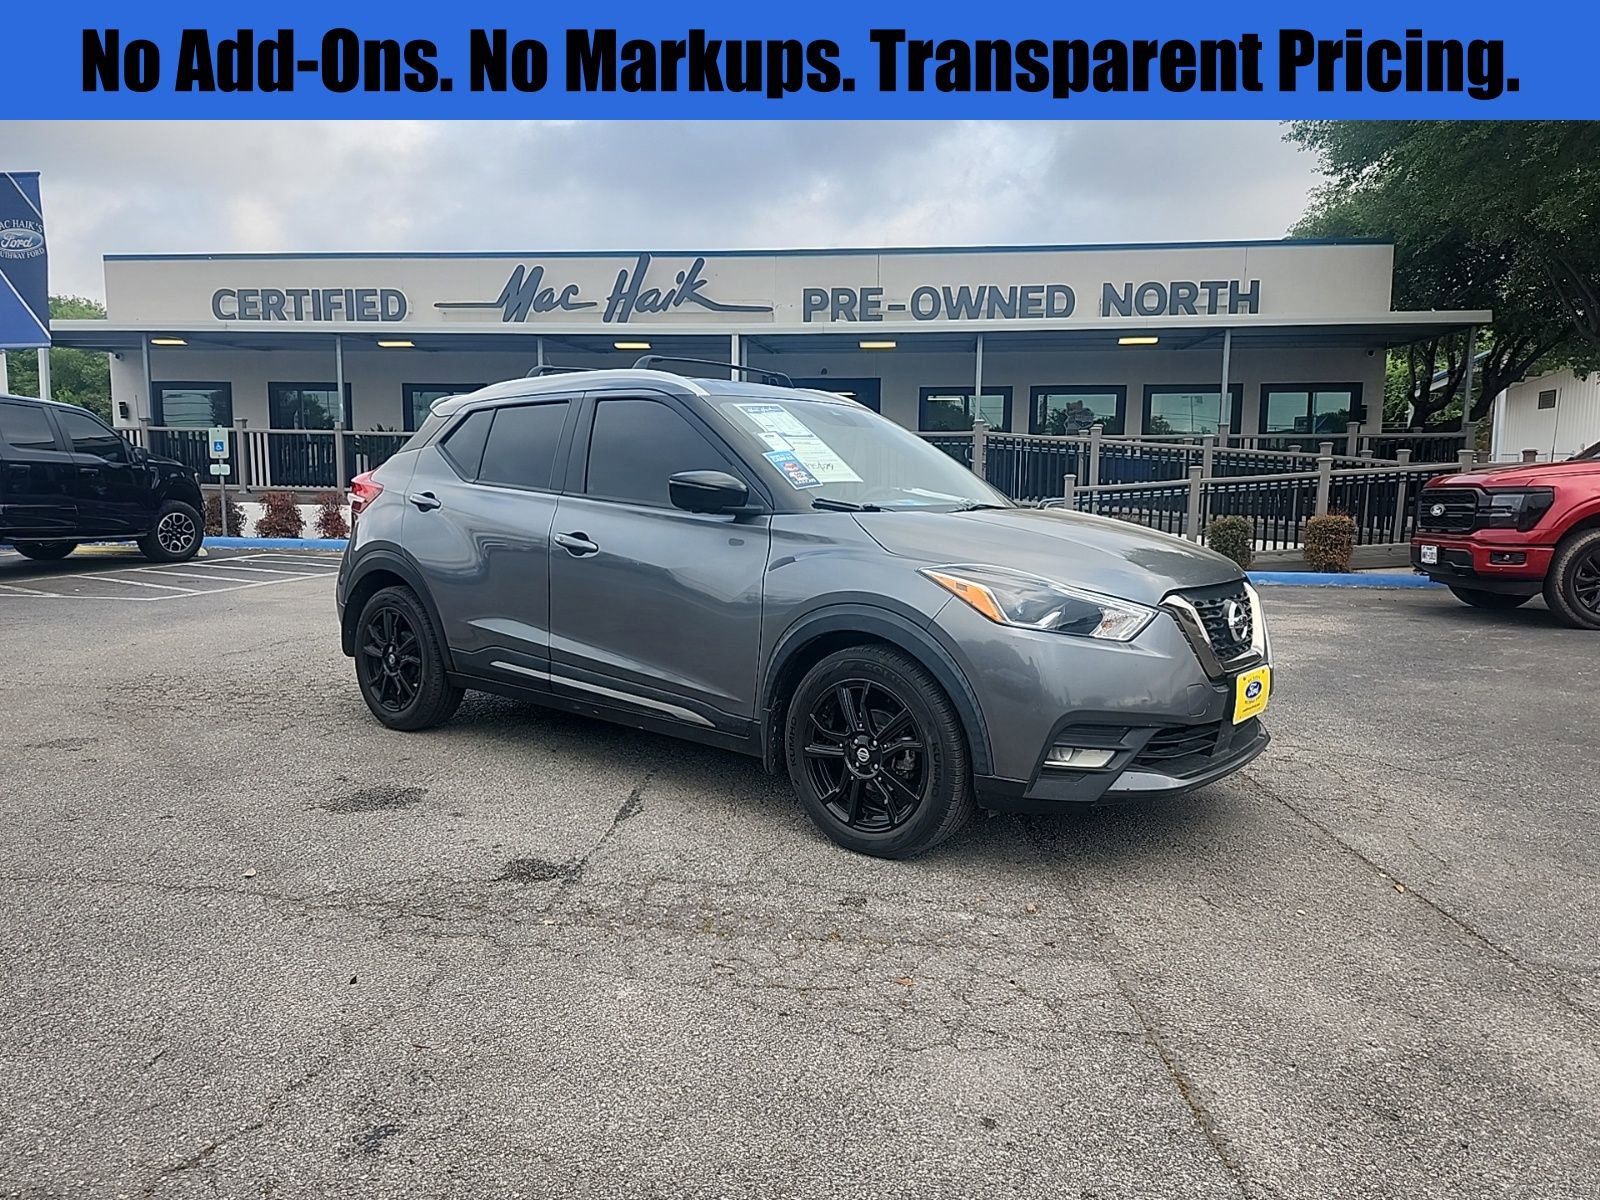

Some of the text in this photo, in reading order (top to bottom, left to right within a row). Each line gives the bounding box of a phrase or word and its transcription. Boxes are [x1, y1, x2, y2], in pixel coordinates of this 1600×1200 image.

[1, 232, 33, 248] Ford
[12, 219, 43, 233] HAIK'S
[27, 247, 45, 259] FORD
[211, 287, 408, 322] CERTIFIED
[434, 253, 773, 323] Mac Haik
[802, 279, 1260, 323] PRE-OWNED NORTH
[789, 716, 798, 767] KUMHO
